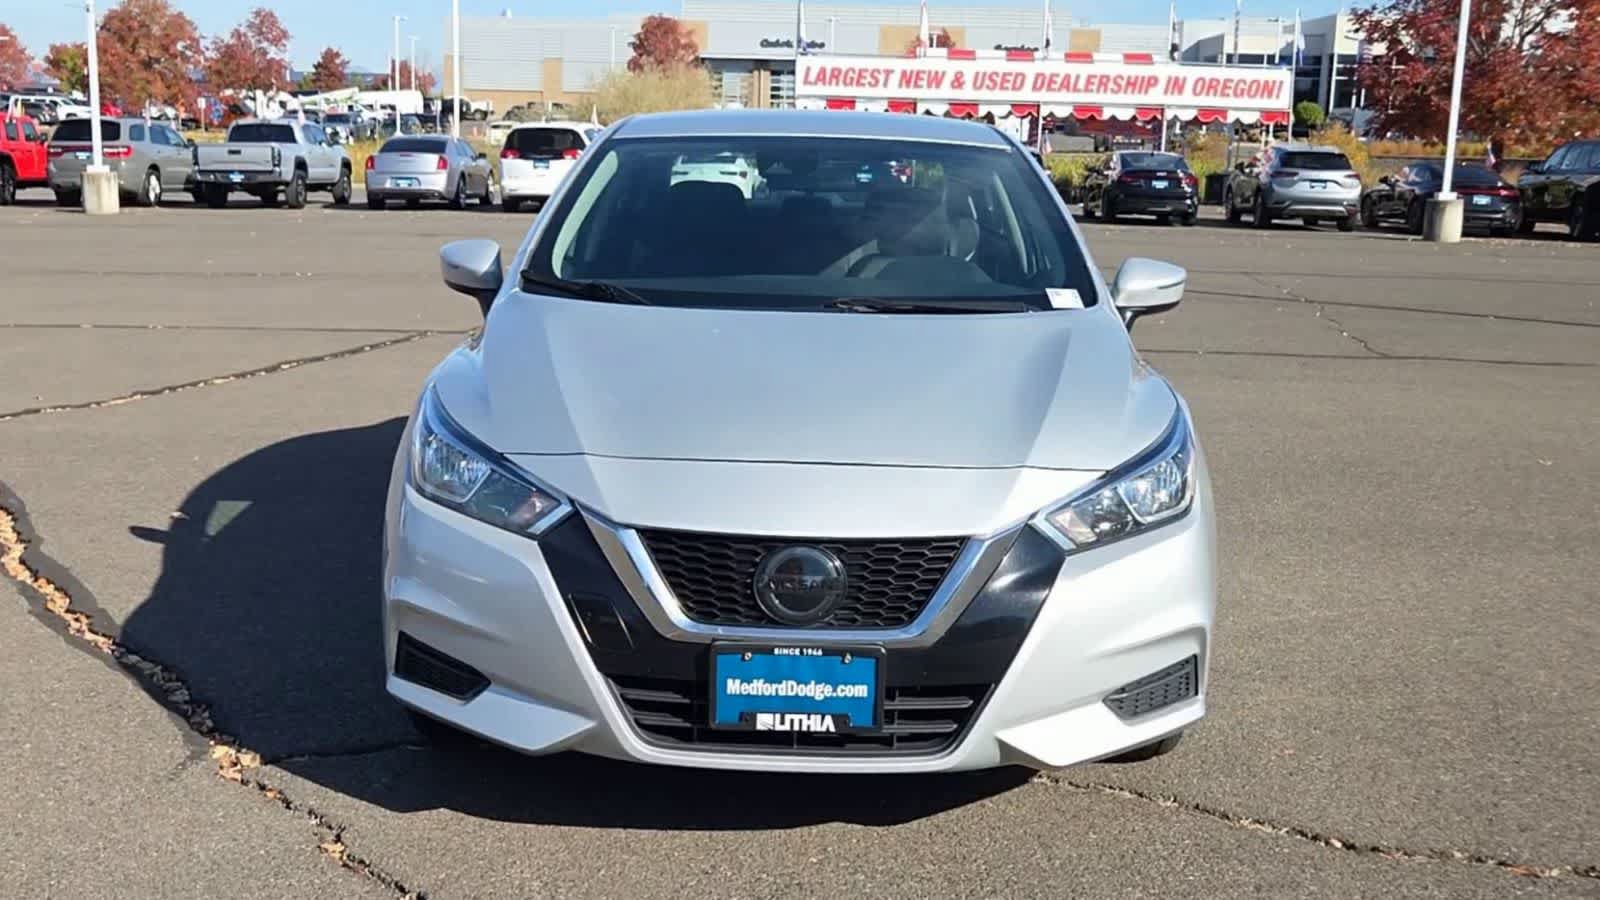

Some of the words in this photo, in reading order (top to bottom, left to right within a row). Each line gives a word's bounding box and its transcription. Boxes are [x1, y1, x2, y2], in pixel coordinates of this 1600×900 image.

[803, 66, 894, 88] LARGEST
[898, 70, 946, 89] NEW
[951, 72, 965, 90] &
[972, 71, 1025, 92] USED
[1032, 72, 1158, 95] DEALERSHIP
[1163, 75, 1187, 96] IN
[1192, 77, 1283, 99] OREGON!
[774, 648, 800, 656] SINCE
[726, 678, 868, 700] MedfordDodge.com
[774, 713, 836, 732] LITHIA
